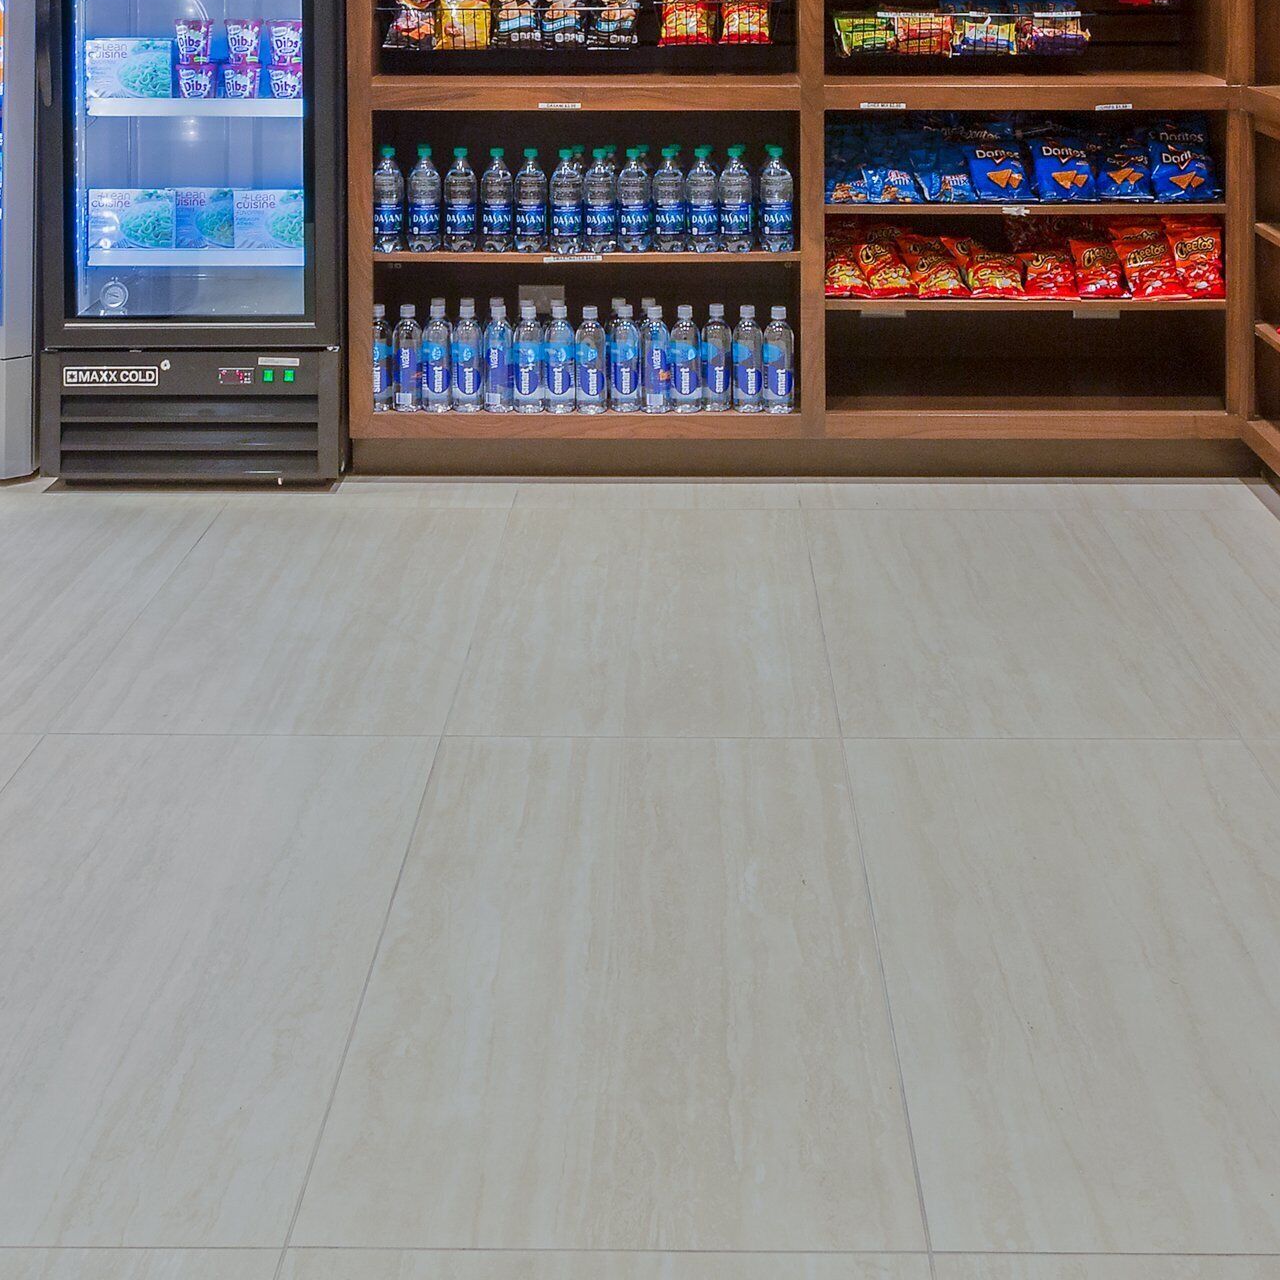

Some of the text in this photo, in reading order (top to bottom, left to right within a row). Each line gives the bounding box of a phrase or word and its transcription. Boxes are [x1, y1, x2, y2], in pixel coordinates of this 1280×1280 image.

[178, 36, 201, 49] Dibs
[275, 37, 299, 49] Dibs
[184, 79, 208, 93] Dibs
[273, 81, 296, 94] Dibs
[1042, 146, 1086, 158] Doritos
[249, 192, 276, 201] Lean
[236, 199, 276, 209] cuisine
[447, 214, 474, 223] DASANI
[483, 214, 511, 223] DASANI
[517, 214, 544, 223] DASANI
[764, 214, 791, 223] DASANI
[1175, 237, 1215, 259] Cheetos
[1127, 245, 1166, 267] Cheetos
[79, 370, 155, 382] MAXX COLD
[588, 368, 597, 395] smart
[622, 368, 630, 393] smart
[681, 368, 689, 394] smart
[715, 367, 723, 392] smart
[746, 368, 755, 394] smart
[777, 369, 785, 395] smart
